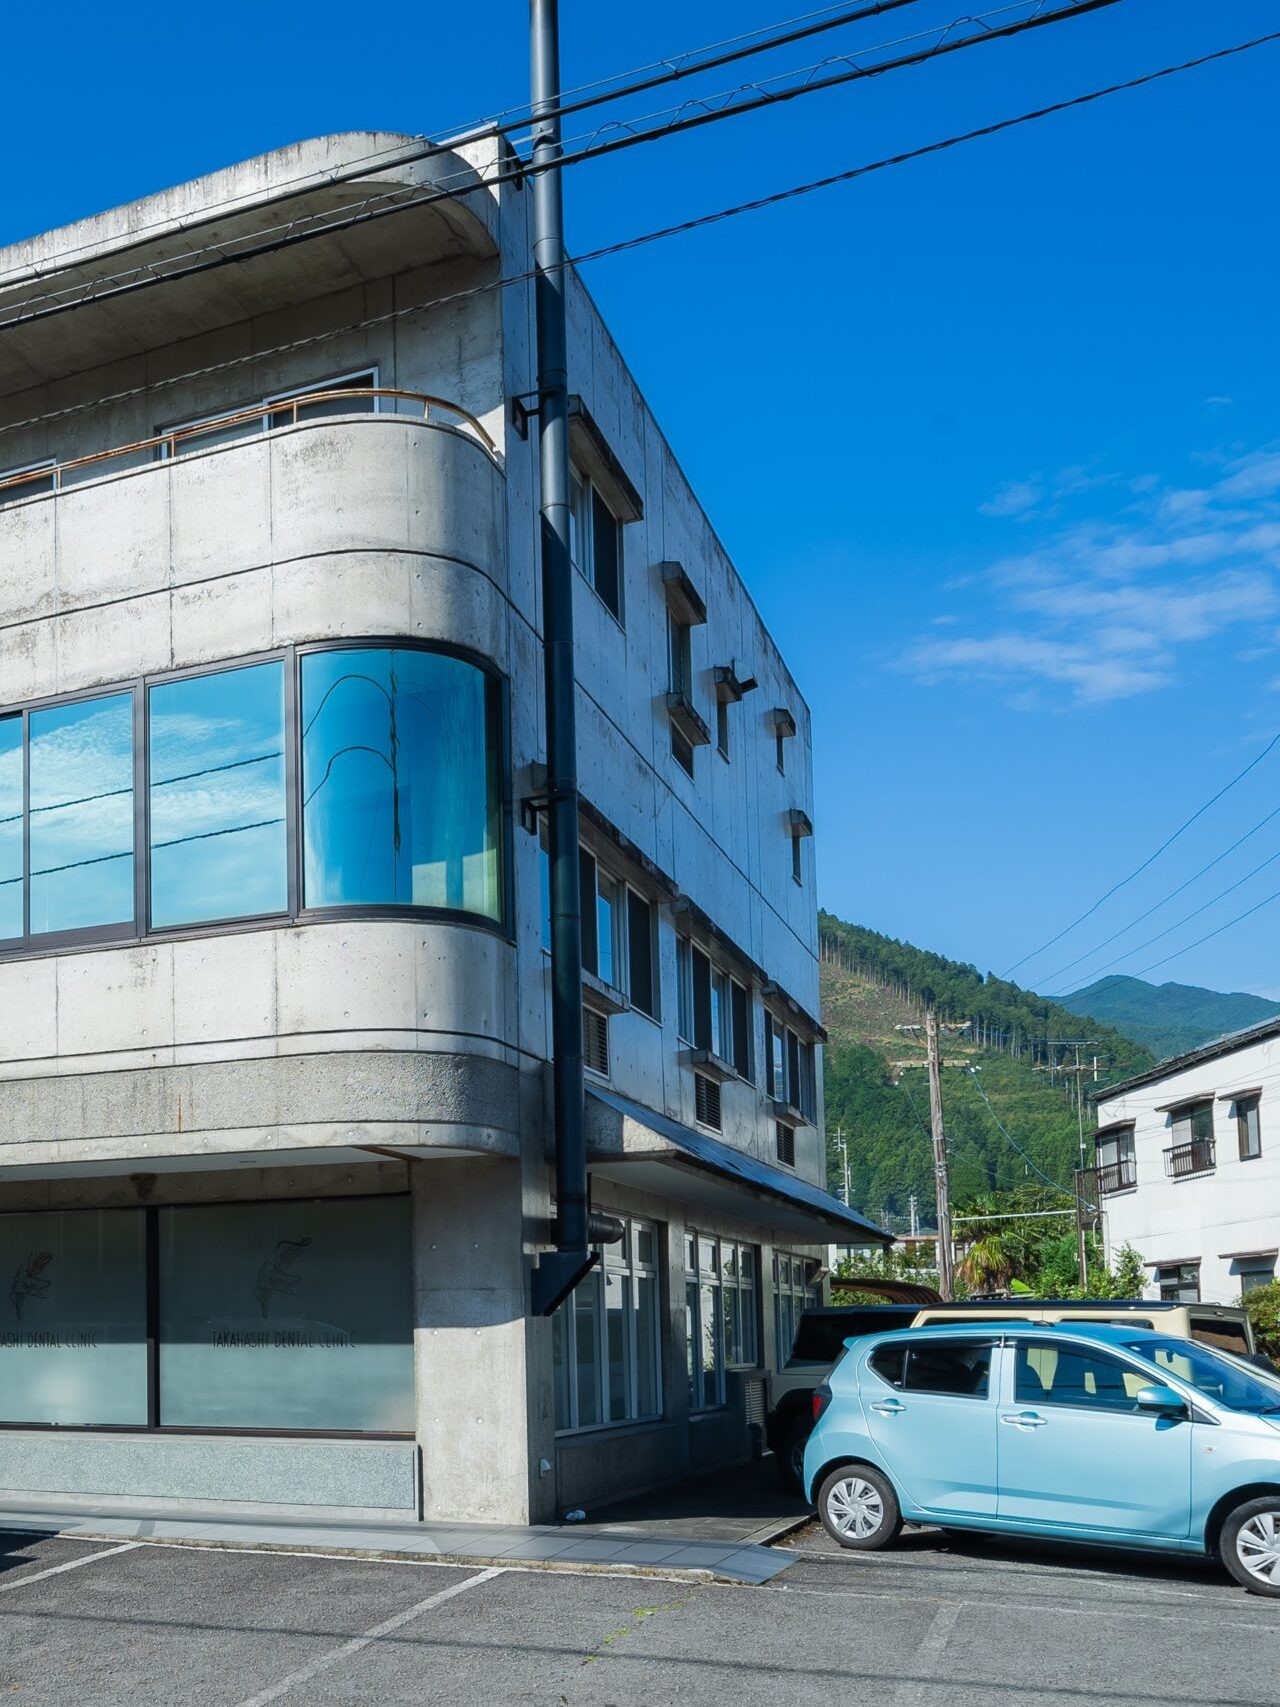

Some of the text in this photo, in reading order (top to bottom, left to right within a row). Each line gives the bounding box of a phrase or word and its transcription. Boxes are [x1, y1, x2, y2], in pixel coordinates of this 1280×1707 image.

[27, 1331, 62, 1348] DENTAL
[65, 1331, 98, 1348] CLINIC
[212, 1330, 357, 1348] TAKAHASHI DENTAL CLINIC
